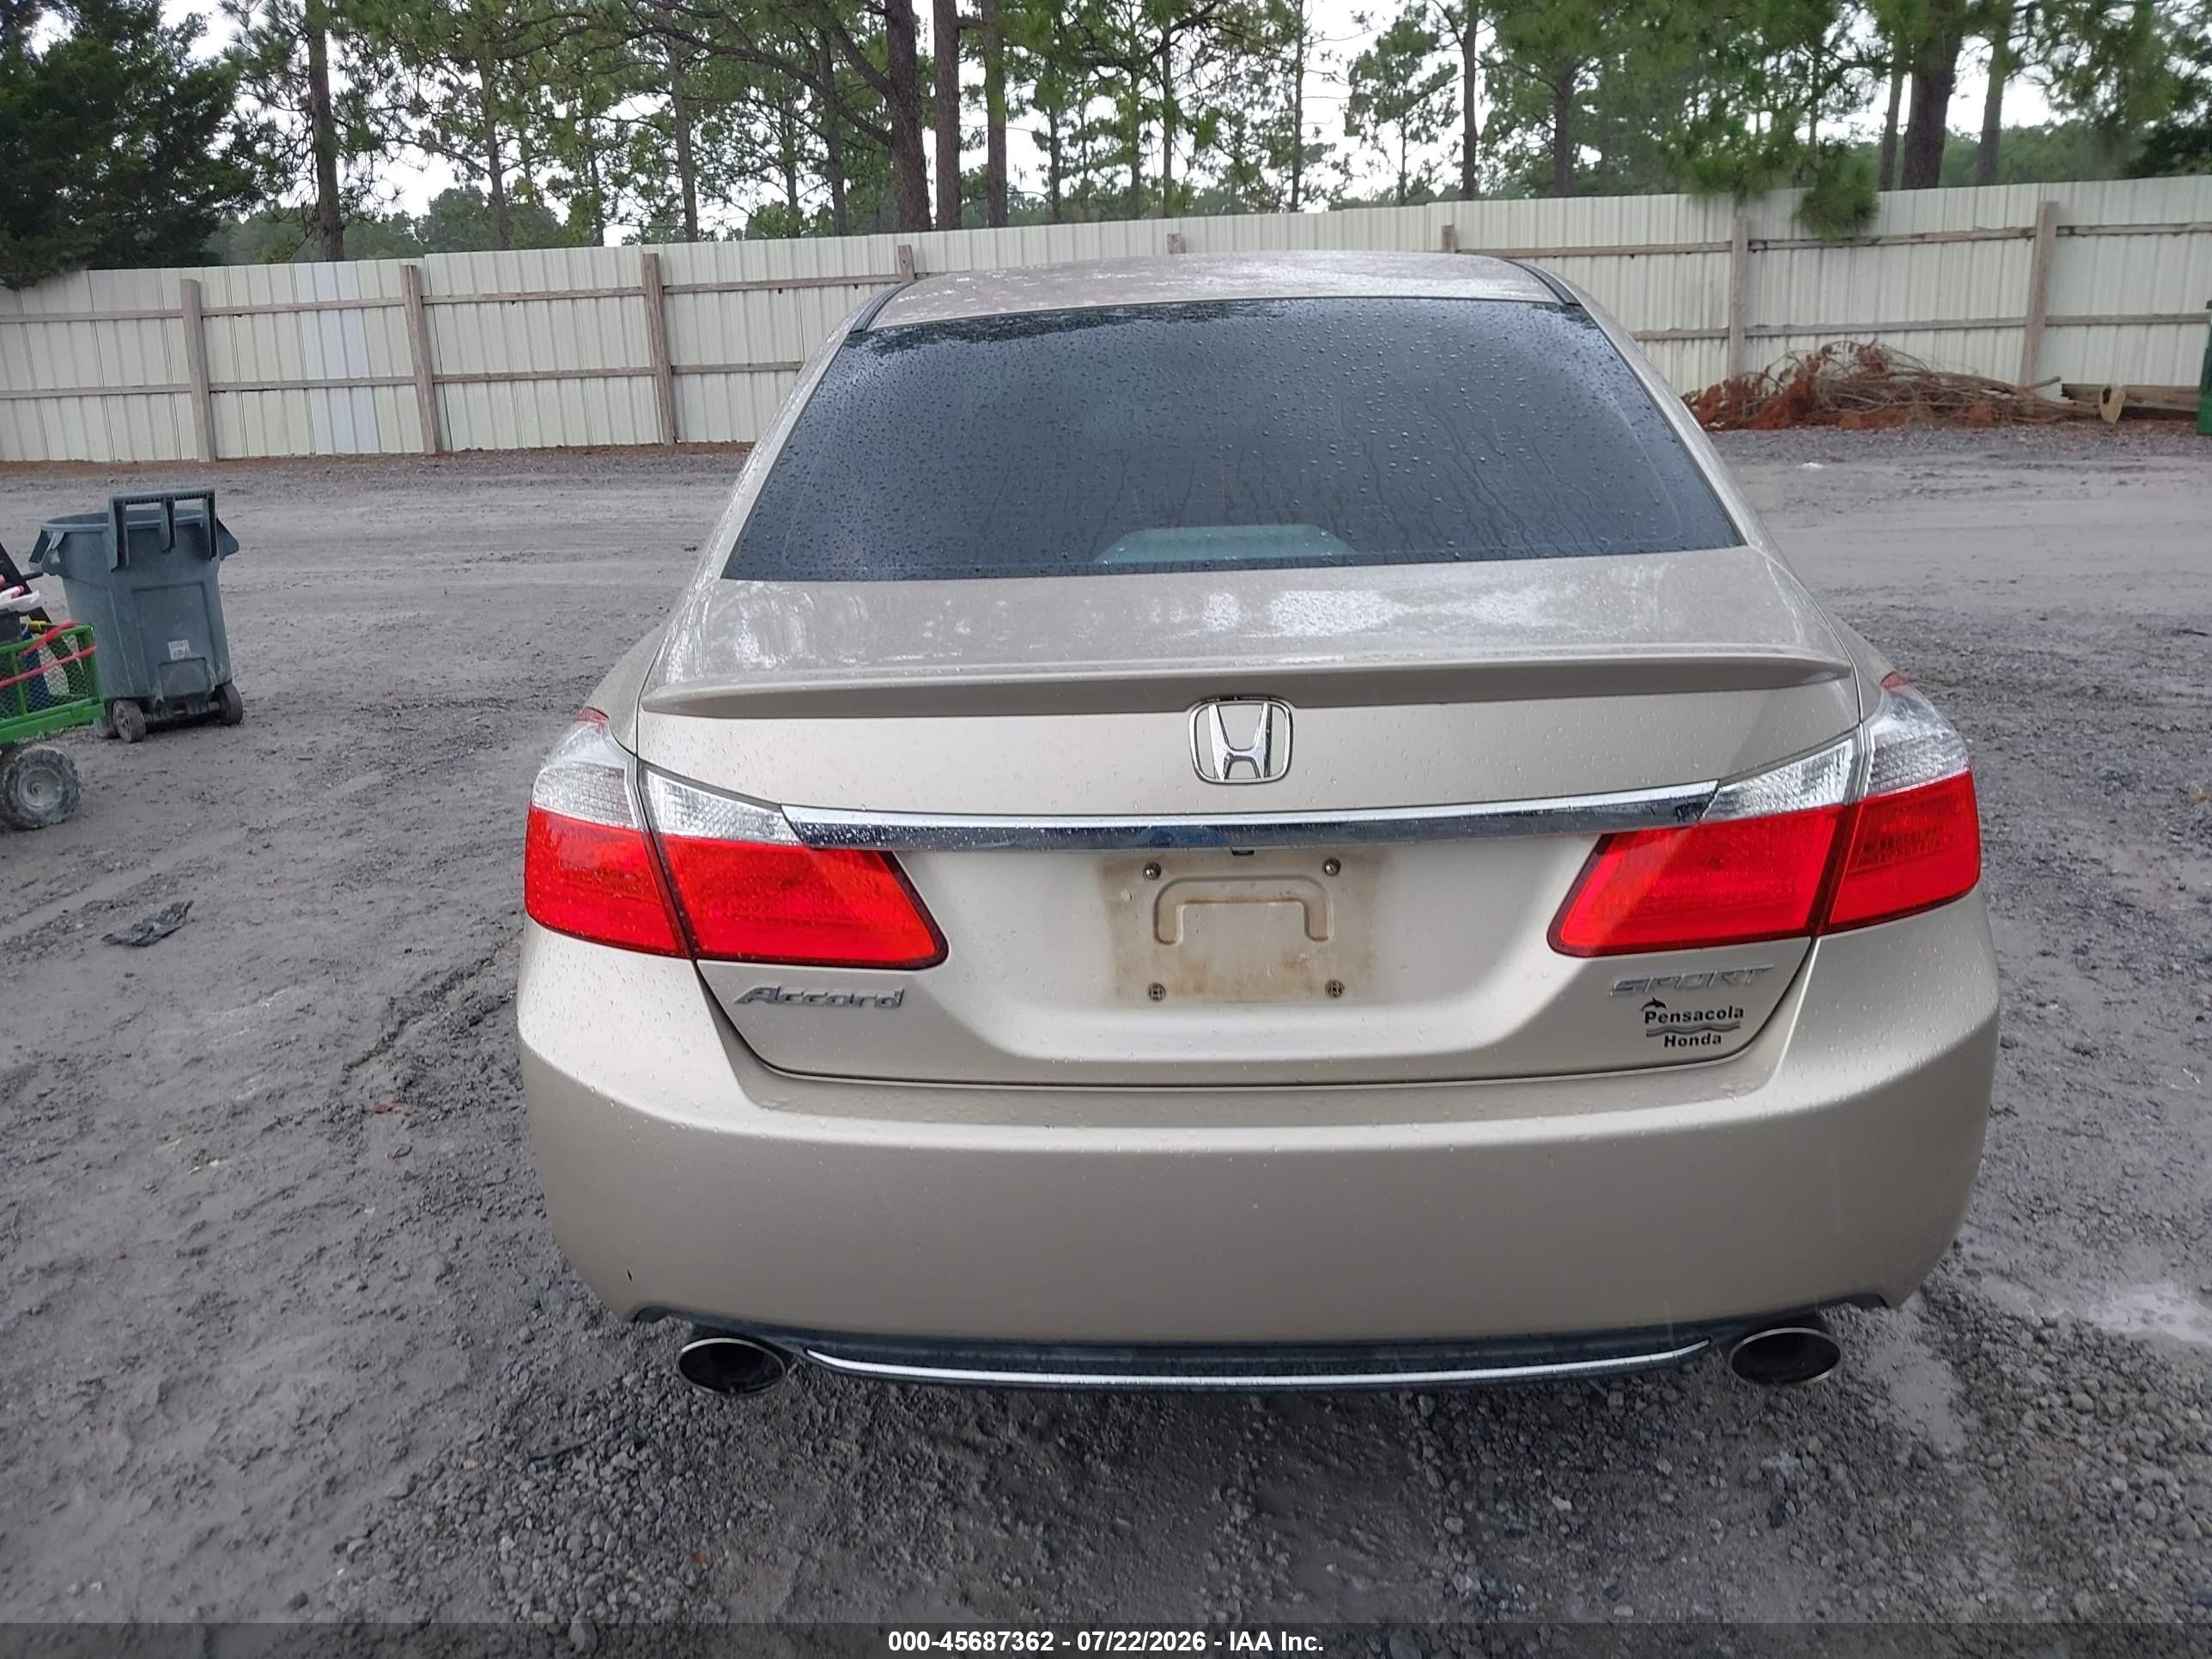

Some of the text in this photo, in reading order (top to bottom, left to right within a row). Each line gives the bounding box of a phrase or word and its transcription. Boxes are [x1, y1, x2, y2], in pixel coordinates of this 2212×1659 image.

[1608, 963, 1775, 997] SPORT
[733, 981, 906, 1010] Accord
[1644, 1005, 1745, 1024] Pensacola
[1662, 1032, 1723, 1048] Honda
